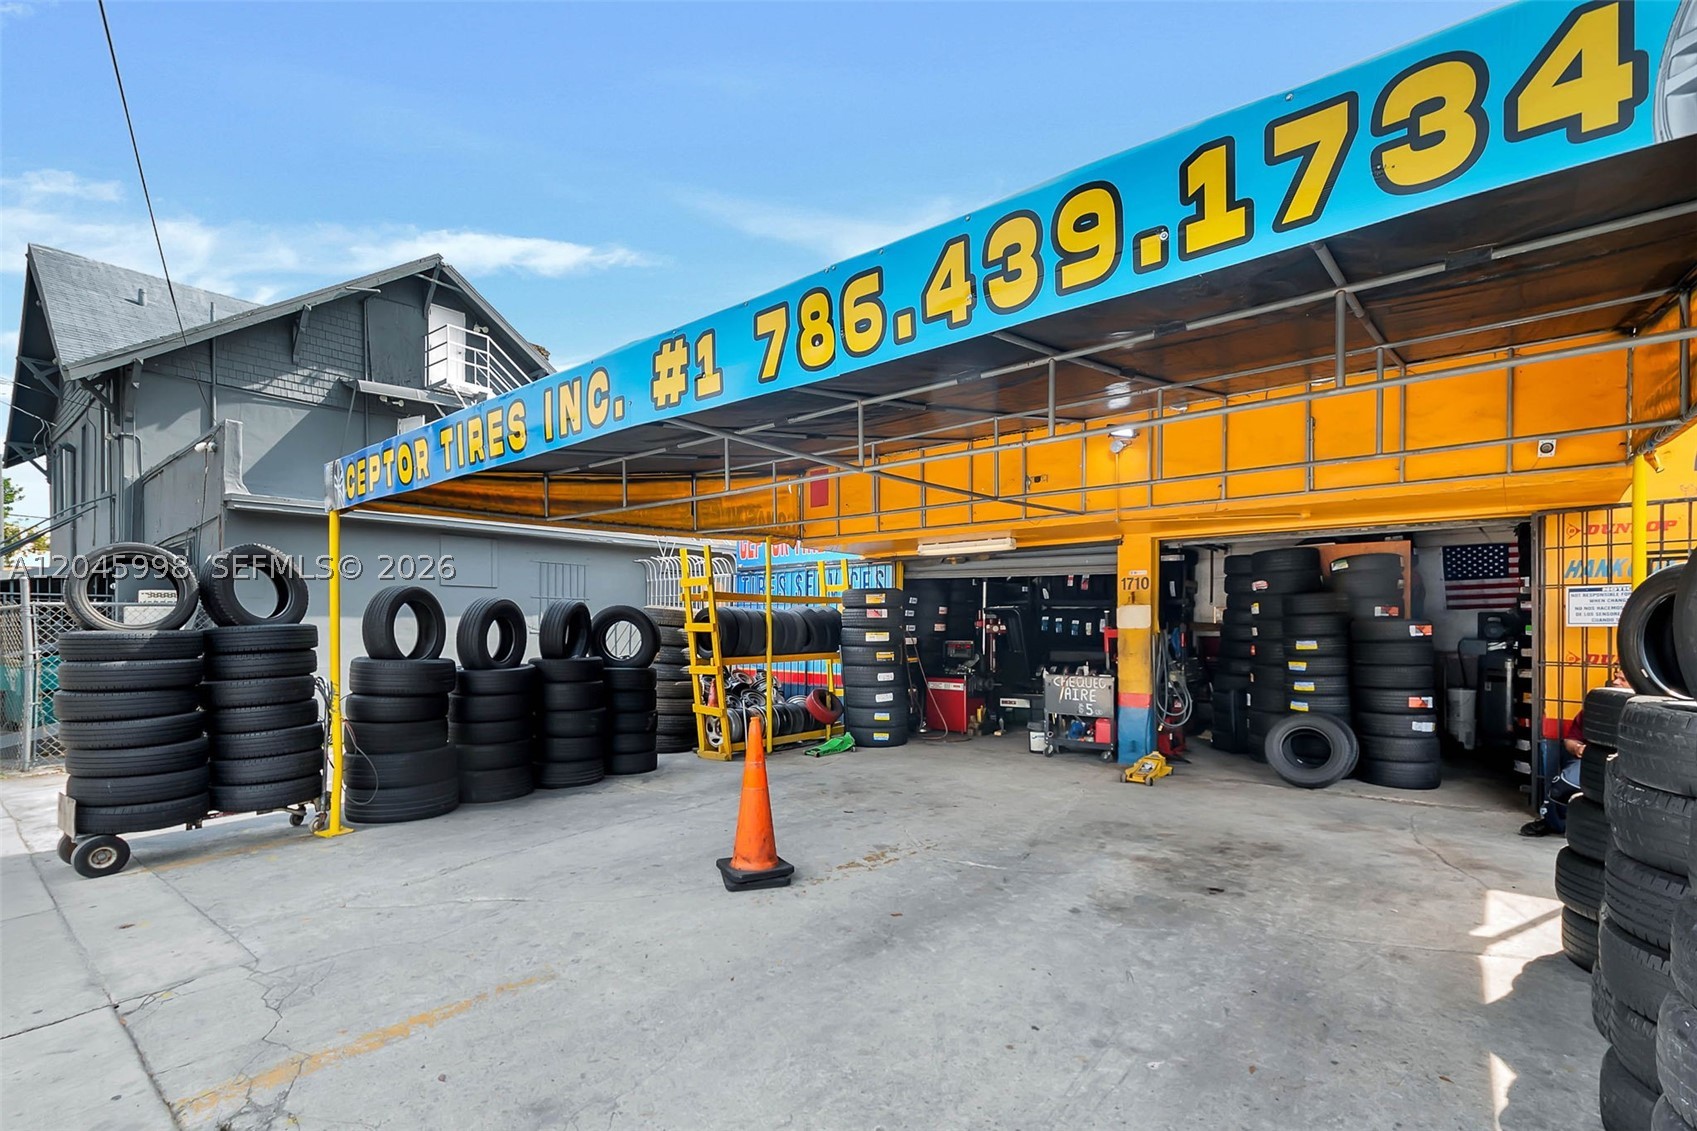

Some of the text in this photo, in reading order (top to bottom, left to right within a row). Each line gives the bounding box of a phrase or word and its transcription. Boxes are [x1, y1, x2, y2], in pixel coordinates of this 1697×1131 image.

[344, 0, 1649, 501] CEPTOR TIRES INC. #1 786.439.1734
[1586, 520, 1677, 536] DUNOP
[794, 569, 885, 597] SEVCES
[1120, 576, 1149, 590] 1710
